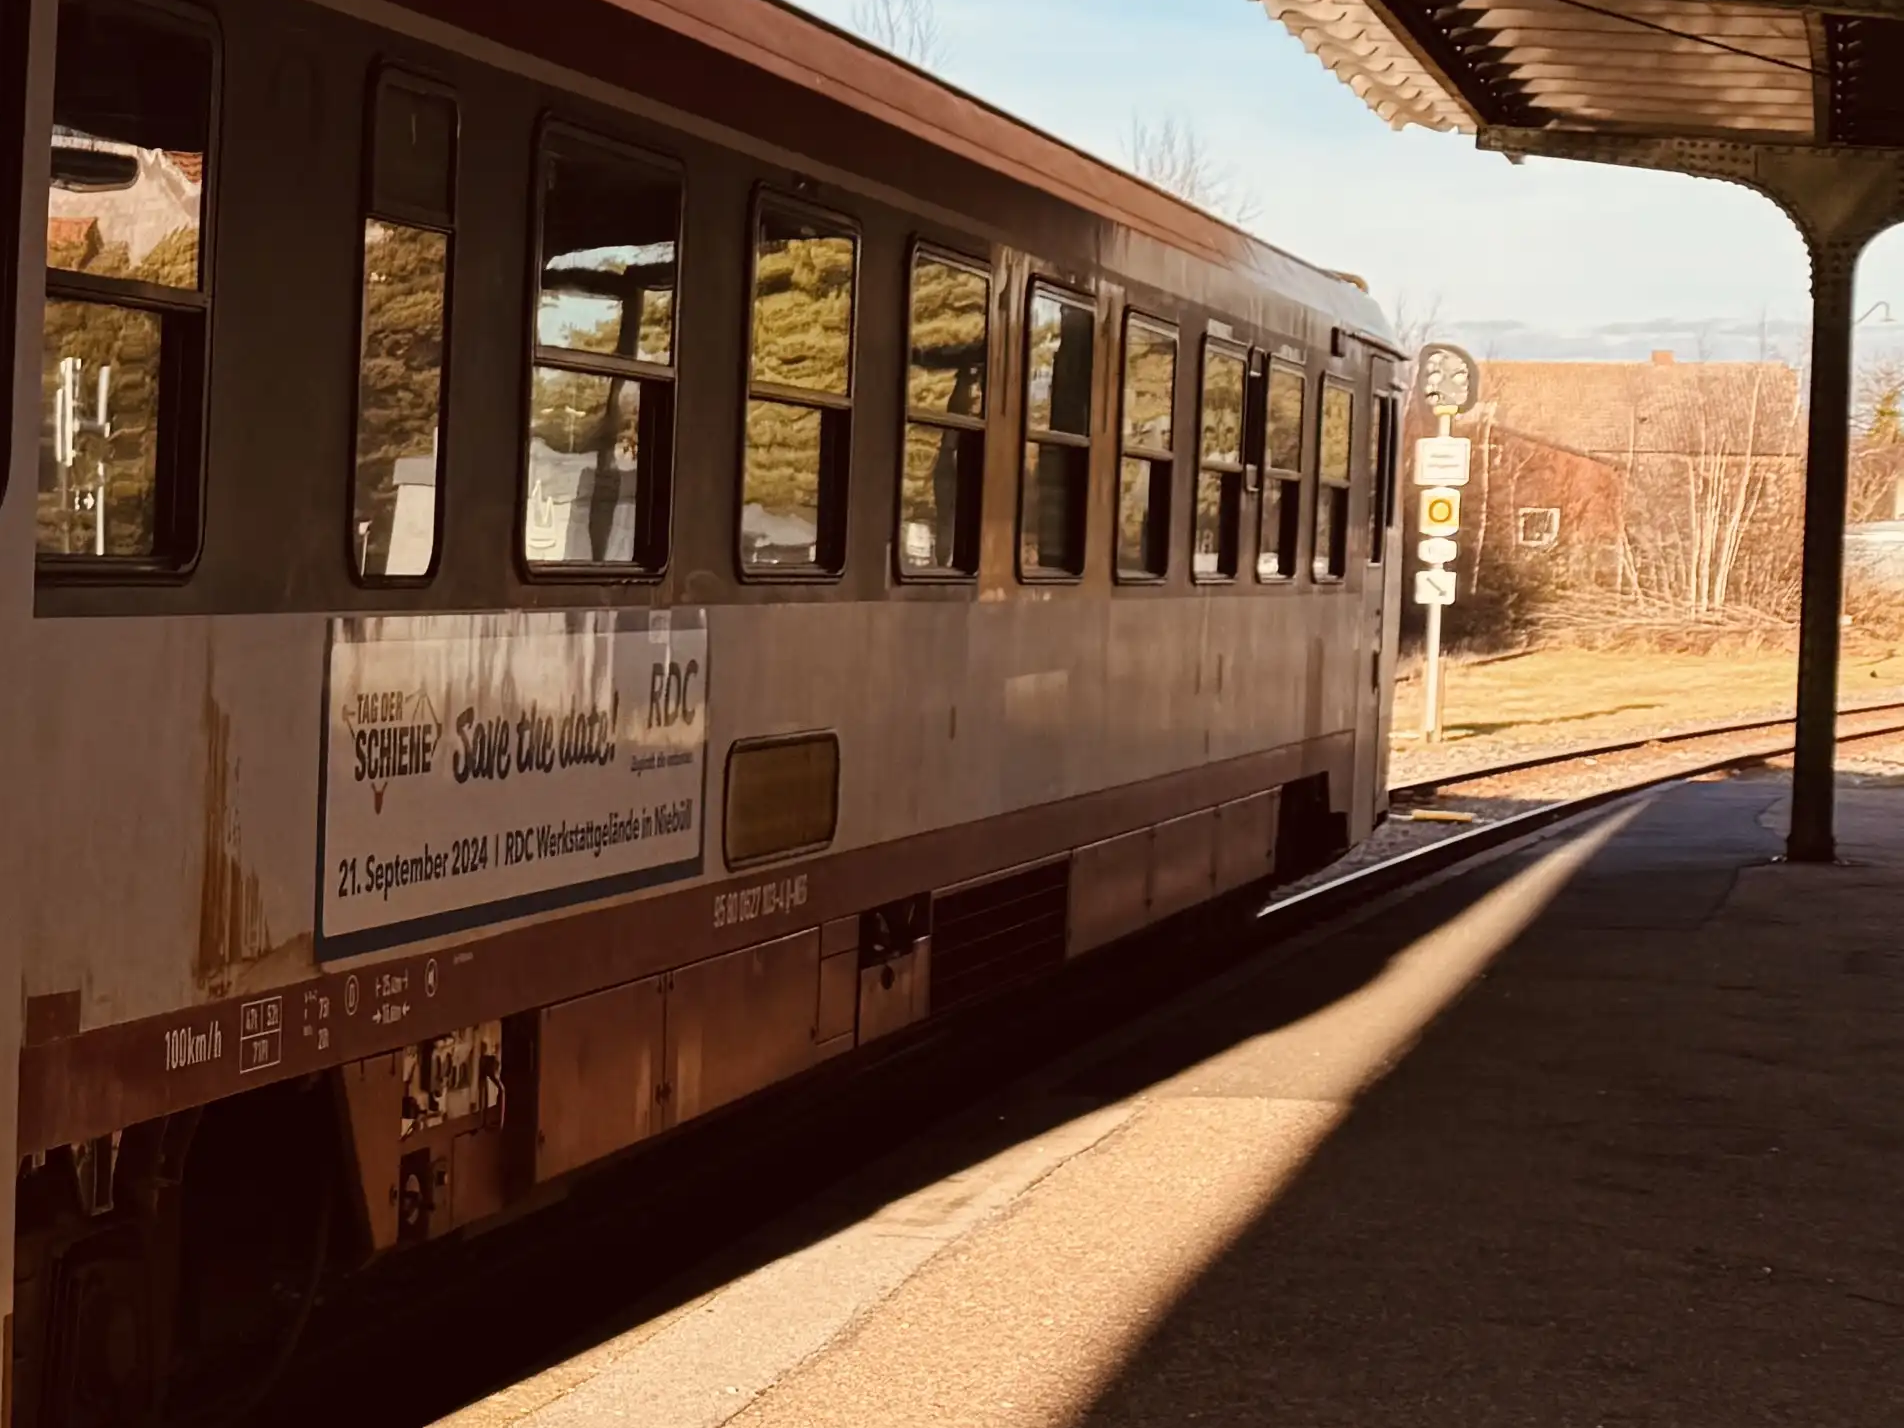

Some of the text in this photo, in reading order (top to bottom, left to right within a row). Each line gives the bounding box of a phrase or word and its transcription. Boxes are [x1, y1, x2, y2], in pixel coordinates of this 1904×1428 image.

[356, 690, 404, 725] TAG DER
[647, 658, 700, 729] RDC
[354, 723, 434, 782] SCHIENE
[452, 690, 621, 784] Save the date!
[338, 857, 361, 898] 21.
[365, 842, 449, 901] September
[452, 834, 488, 876] 2024
[504, 828, 534, 866] RDC
[536, 807, 639, 858] Werkstattgelände
[641, 807, 653, 841] in
[655, 798, 694, 837] Niebüll
[164, 1020, 223, 1072] 100km/h
